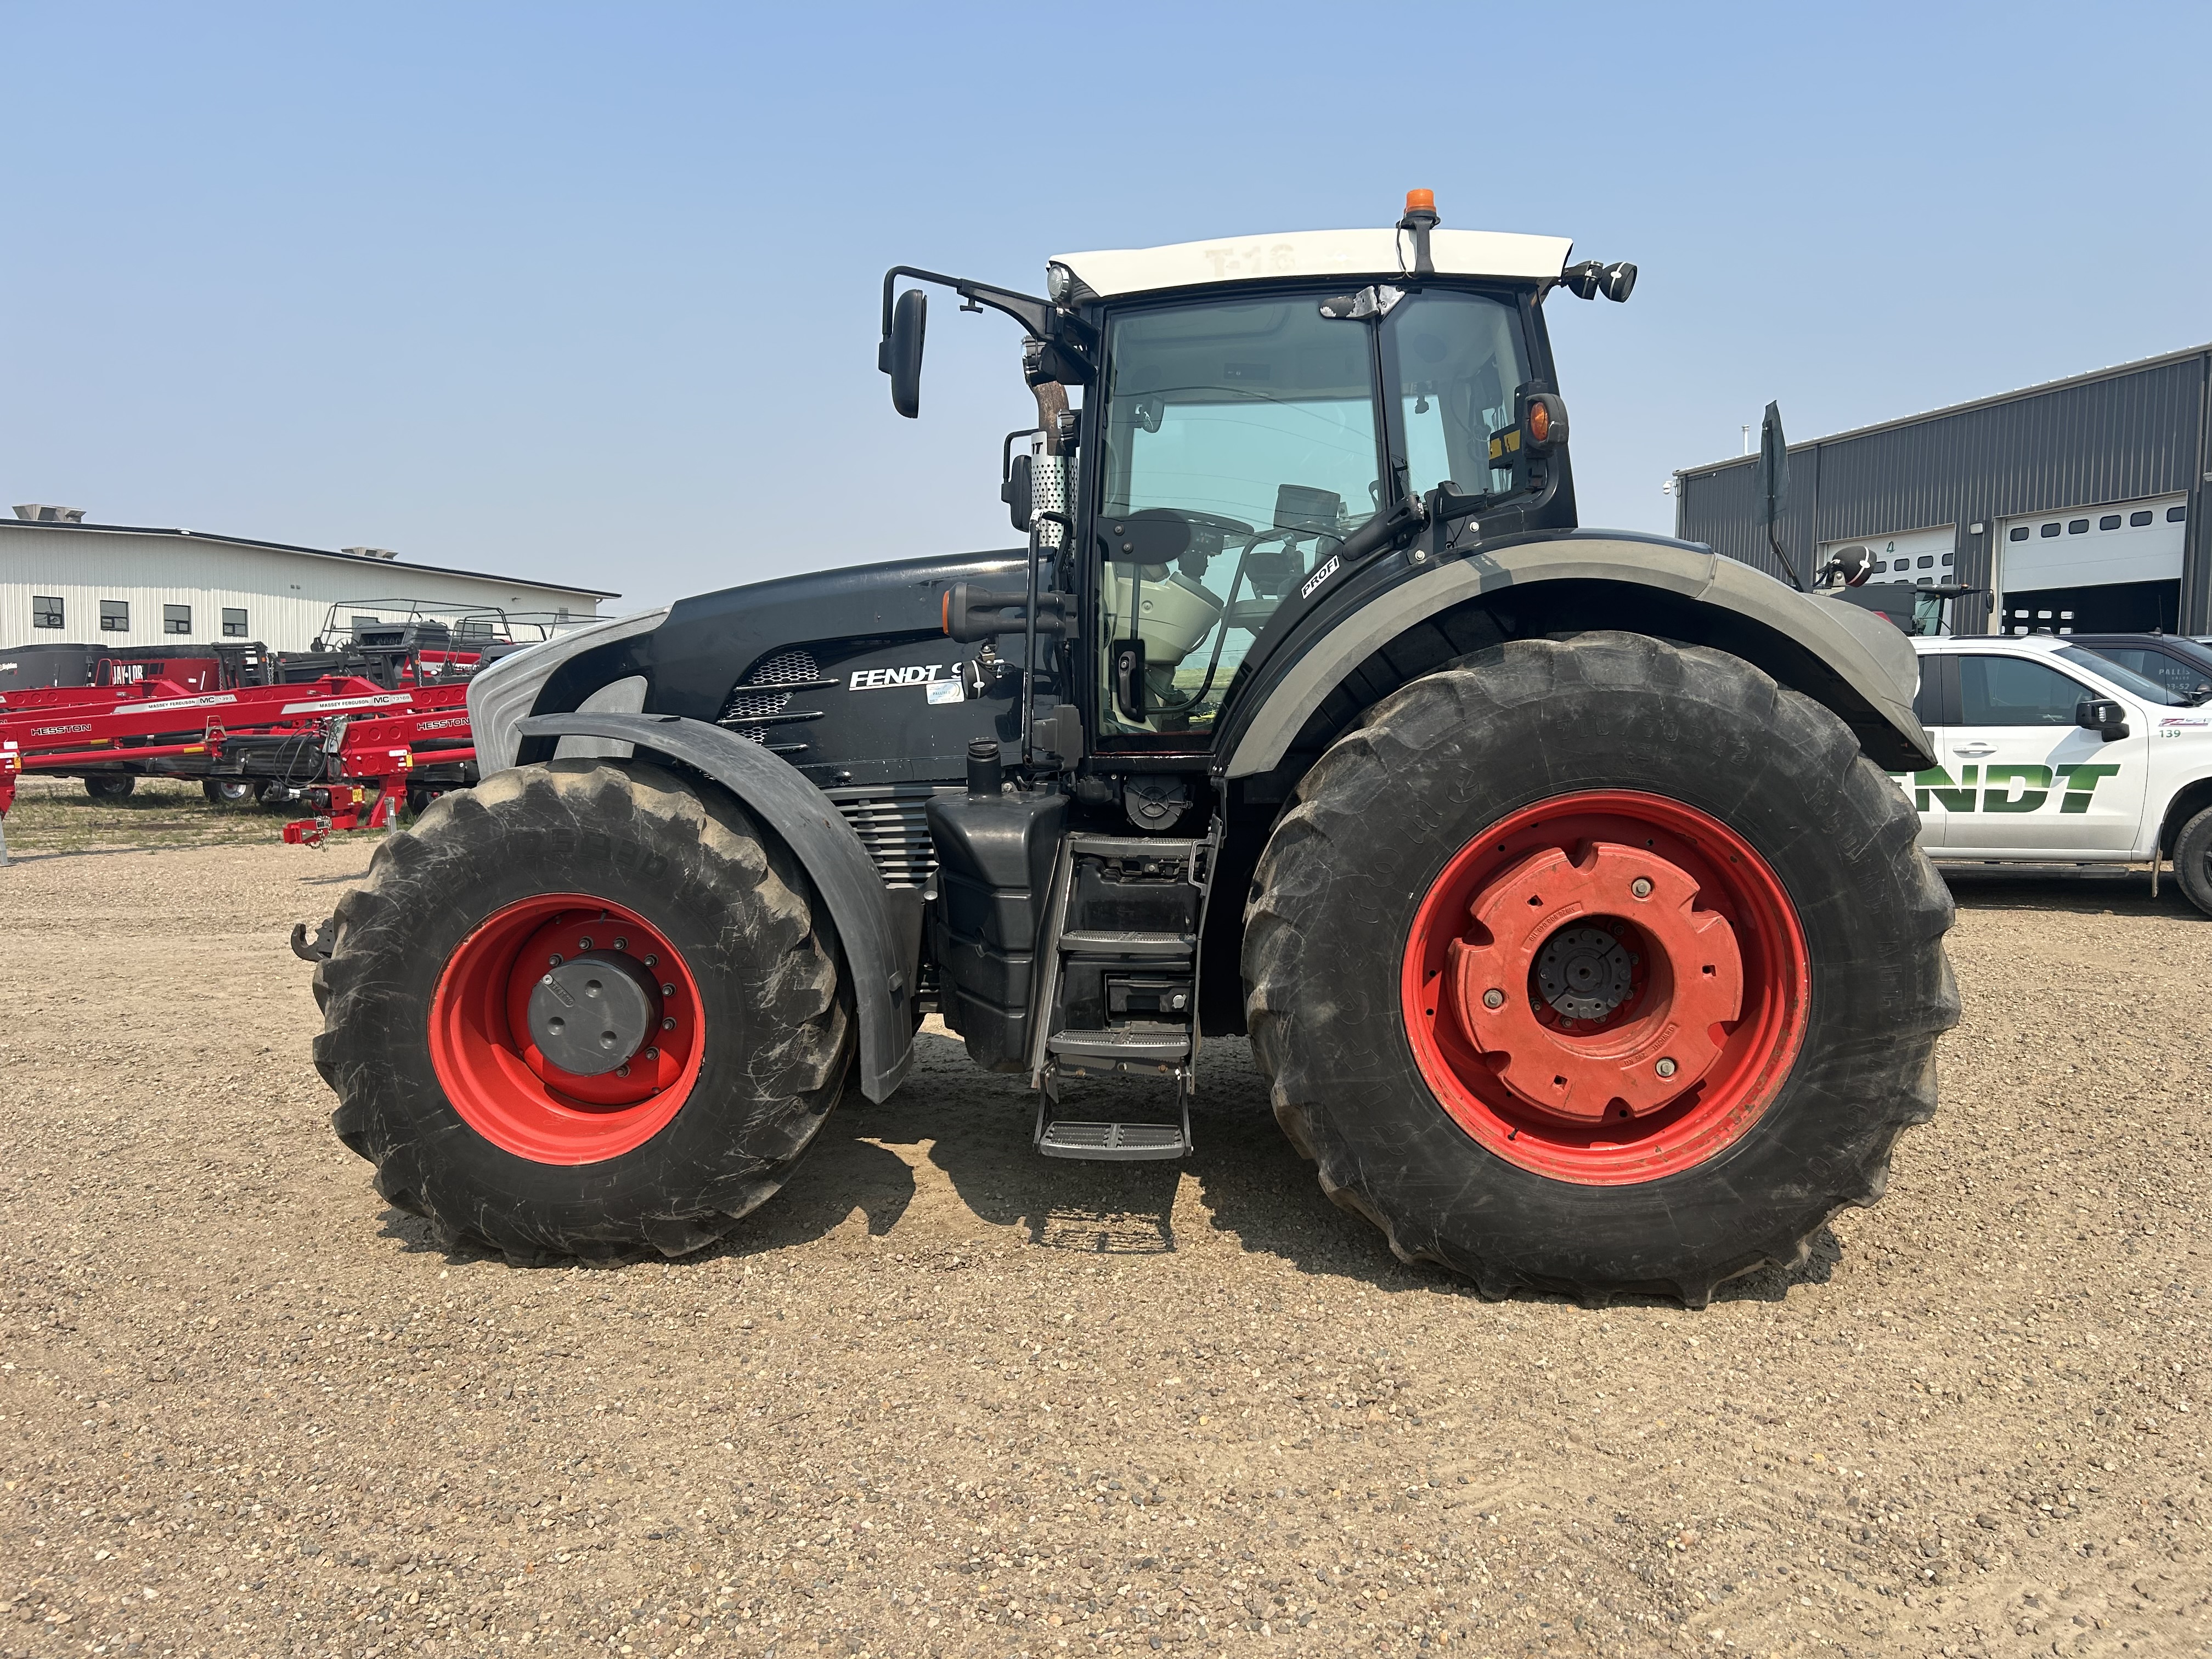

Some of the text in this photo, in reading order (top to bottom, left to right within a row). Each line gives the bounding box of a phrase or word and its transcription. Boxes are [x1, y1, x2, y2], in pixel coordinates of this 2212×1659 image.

[1887, 541, 1895, 553] 4
[1303, 557, 1338, 596] PROFI
[850, 664, 943, 687] FENDT
[31, 724, 92, 736] HESSTON
[417, 717, 471, 731] HESSTON
